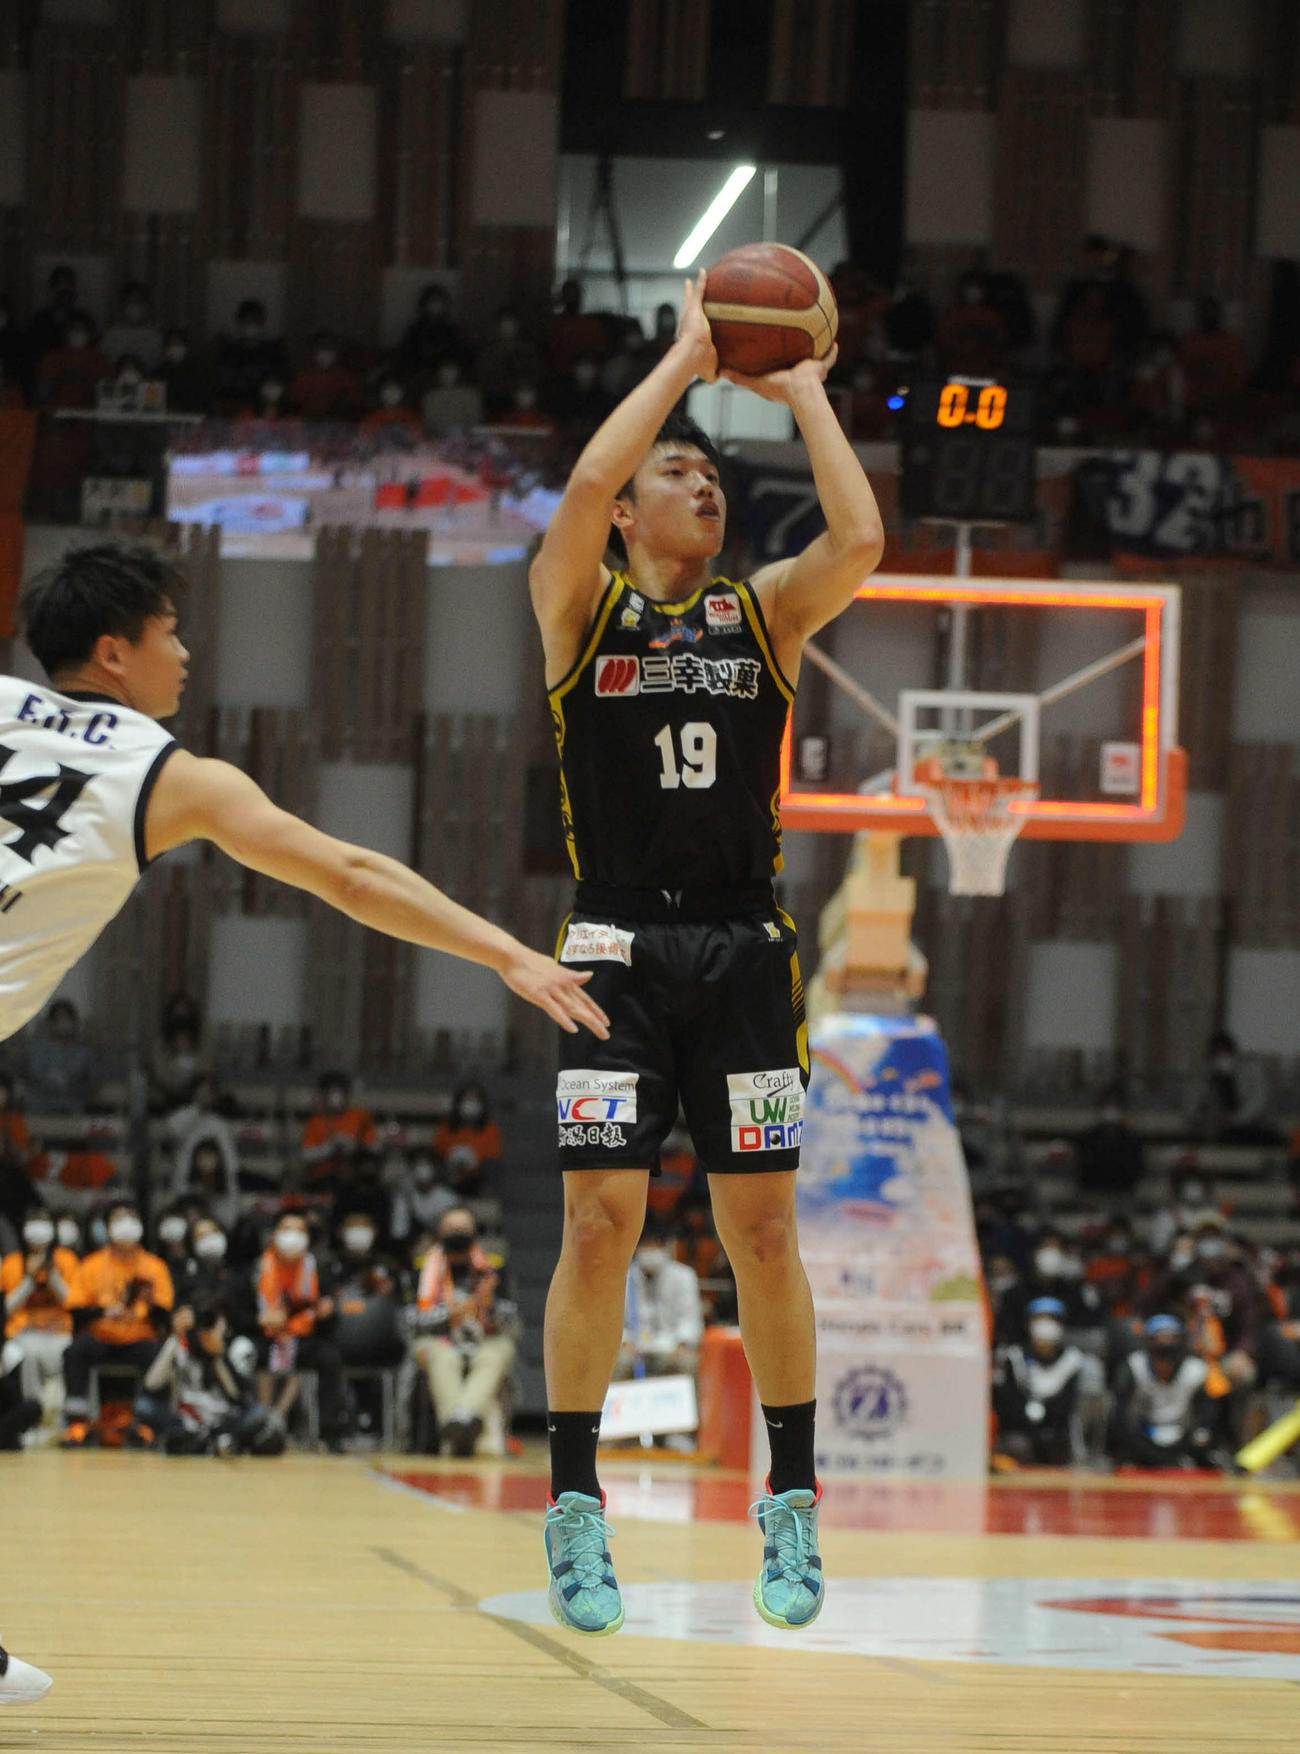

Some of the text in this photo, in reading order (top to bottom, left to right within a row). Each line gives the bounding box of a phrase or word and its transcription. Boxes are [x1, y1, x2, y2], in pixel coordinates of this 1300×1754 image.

[937, 383, 1008, 429] 0.0
[1106, 451, 1223, 549] 32
[640, 653, 761, 700] 三幸製菓
[654, 722, 717, 789] 19
[594, 1078, 635, 1093] System
